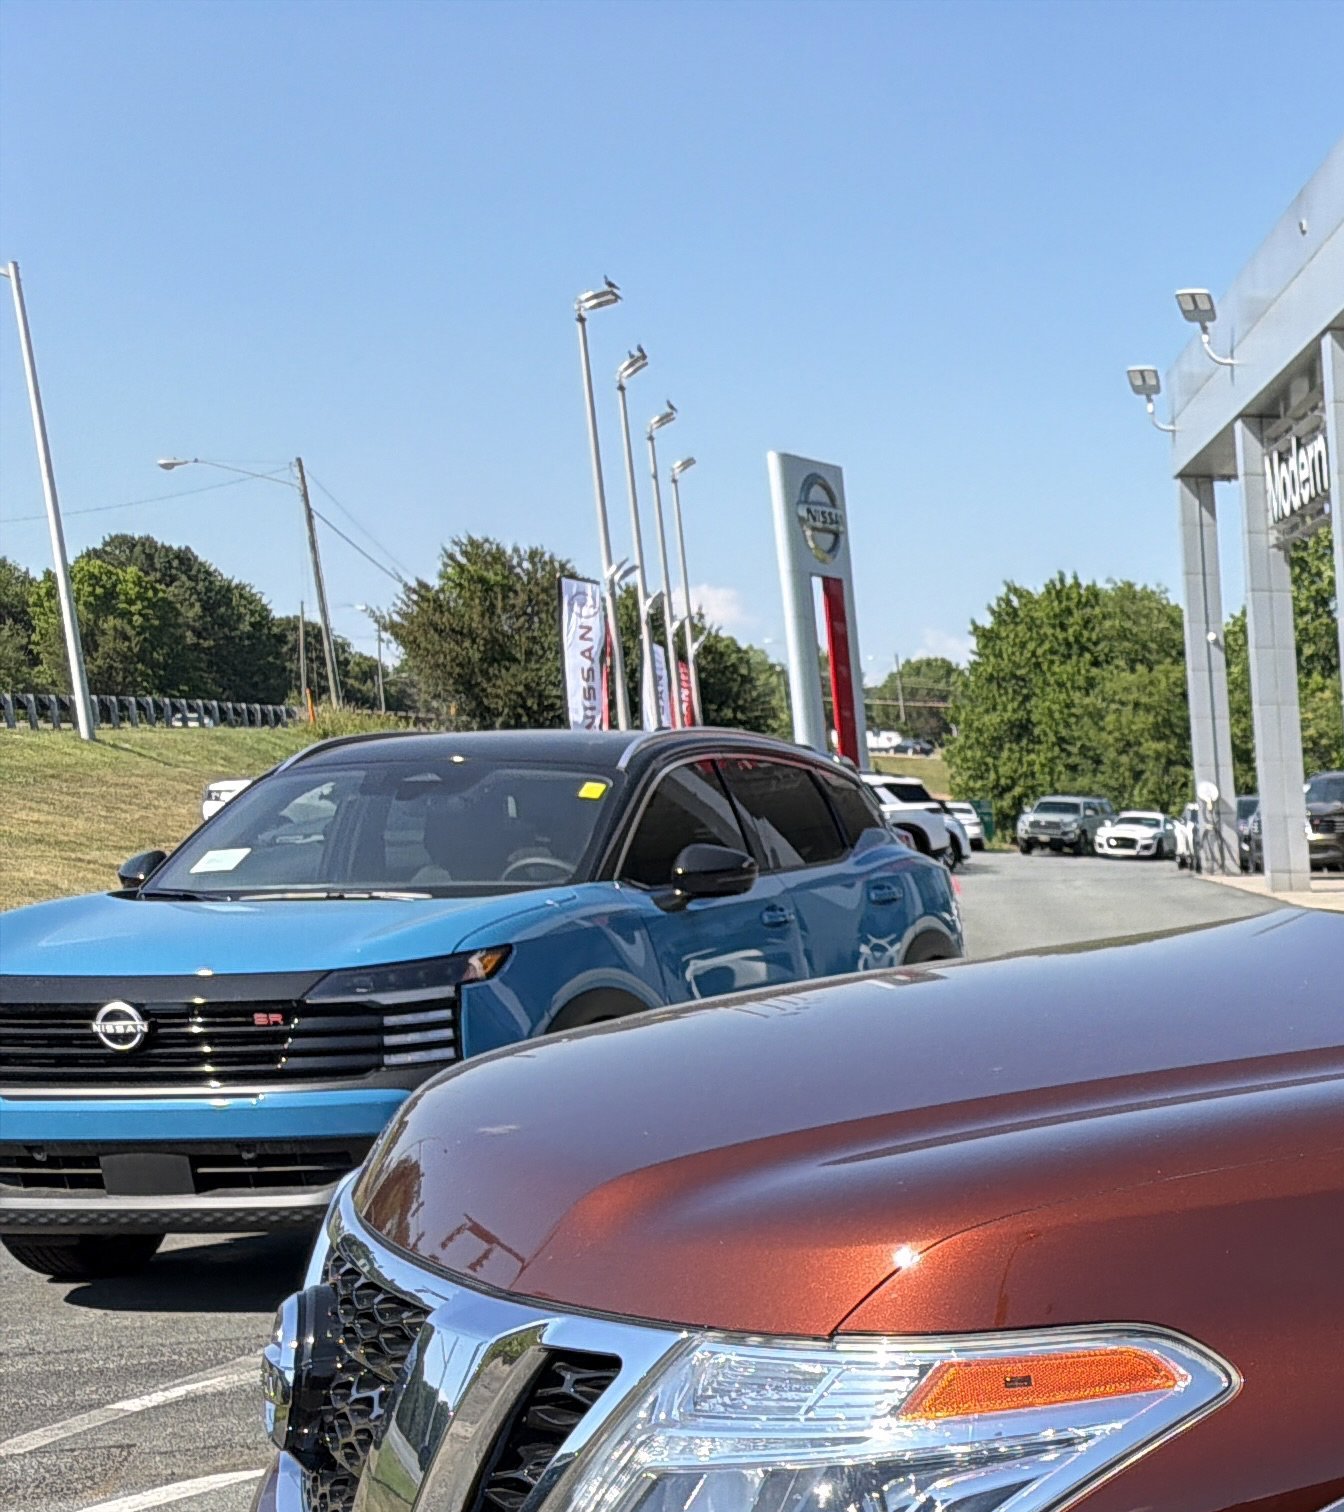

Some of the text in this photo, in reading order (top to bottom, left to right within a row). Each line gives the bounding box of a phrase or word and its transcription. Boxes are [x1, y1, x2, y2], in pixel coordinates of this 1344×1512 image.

[1264, 434, 1329, 525] Modern
[253, 1012, 284, 1026] SR
[92, 1023, 149, 1034] NISSAN
